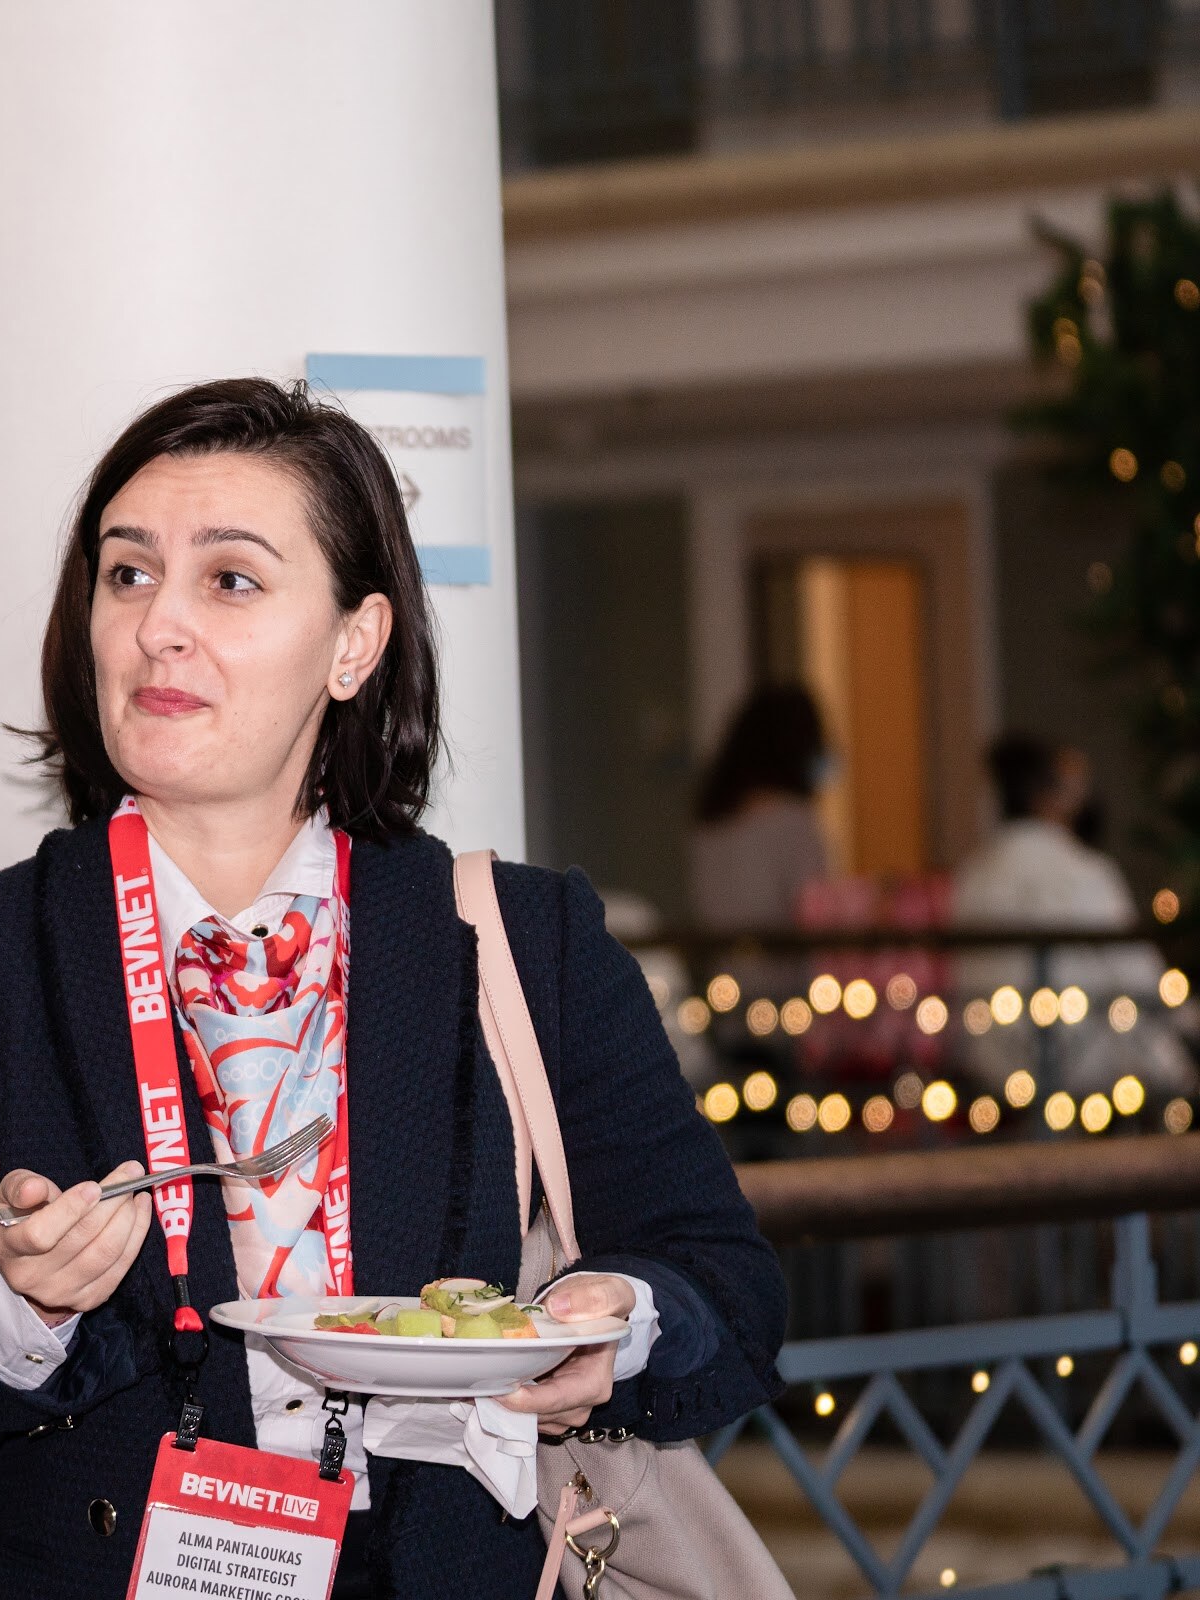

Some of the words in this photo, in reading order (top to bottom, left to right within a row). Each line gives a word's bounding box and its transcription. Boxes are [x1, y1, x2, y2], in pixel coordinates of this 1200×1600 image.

[283, 1496, 318, 1519] LIVE
[178, 1531, 213, 1550] ALMA
[216, 1537, 303, 1566] PANTALOUKAS
[146, 1570, 197, 1592] AURORA
[200, 1580, 272, 1600] MARKETING
[176, 1553, 222, 1574] DIGITAL
[226, 1562, 297, 1587] STRATEGIST
